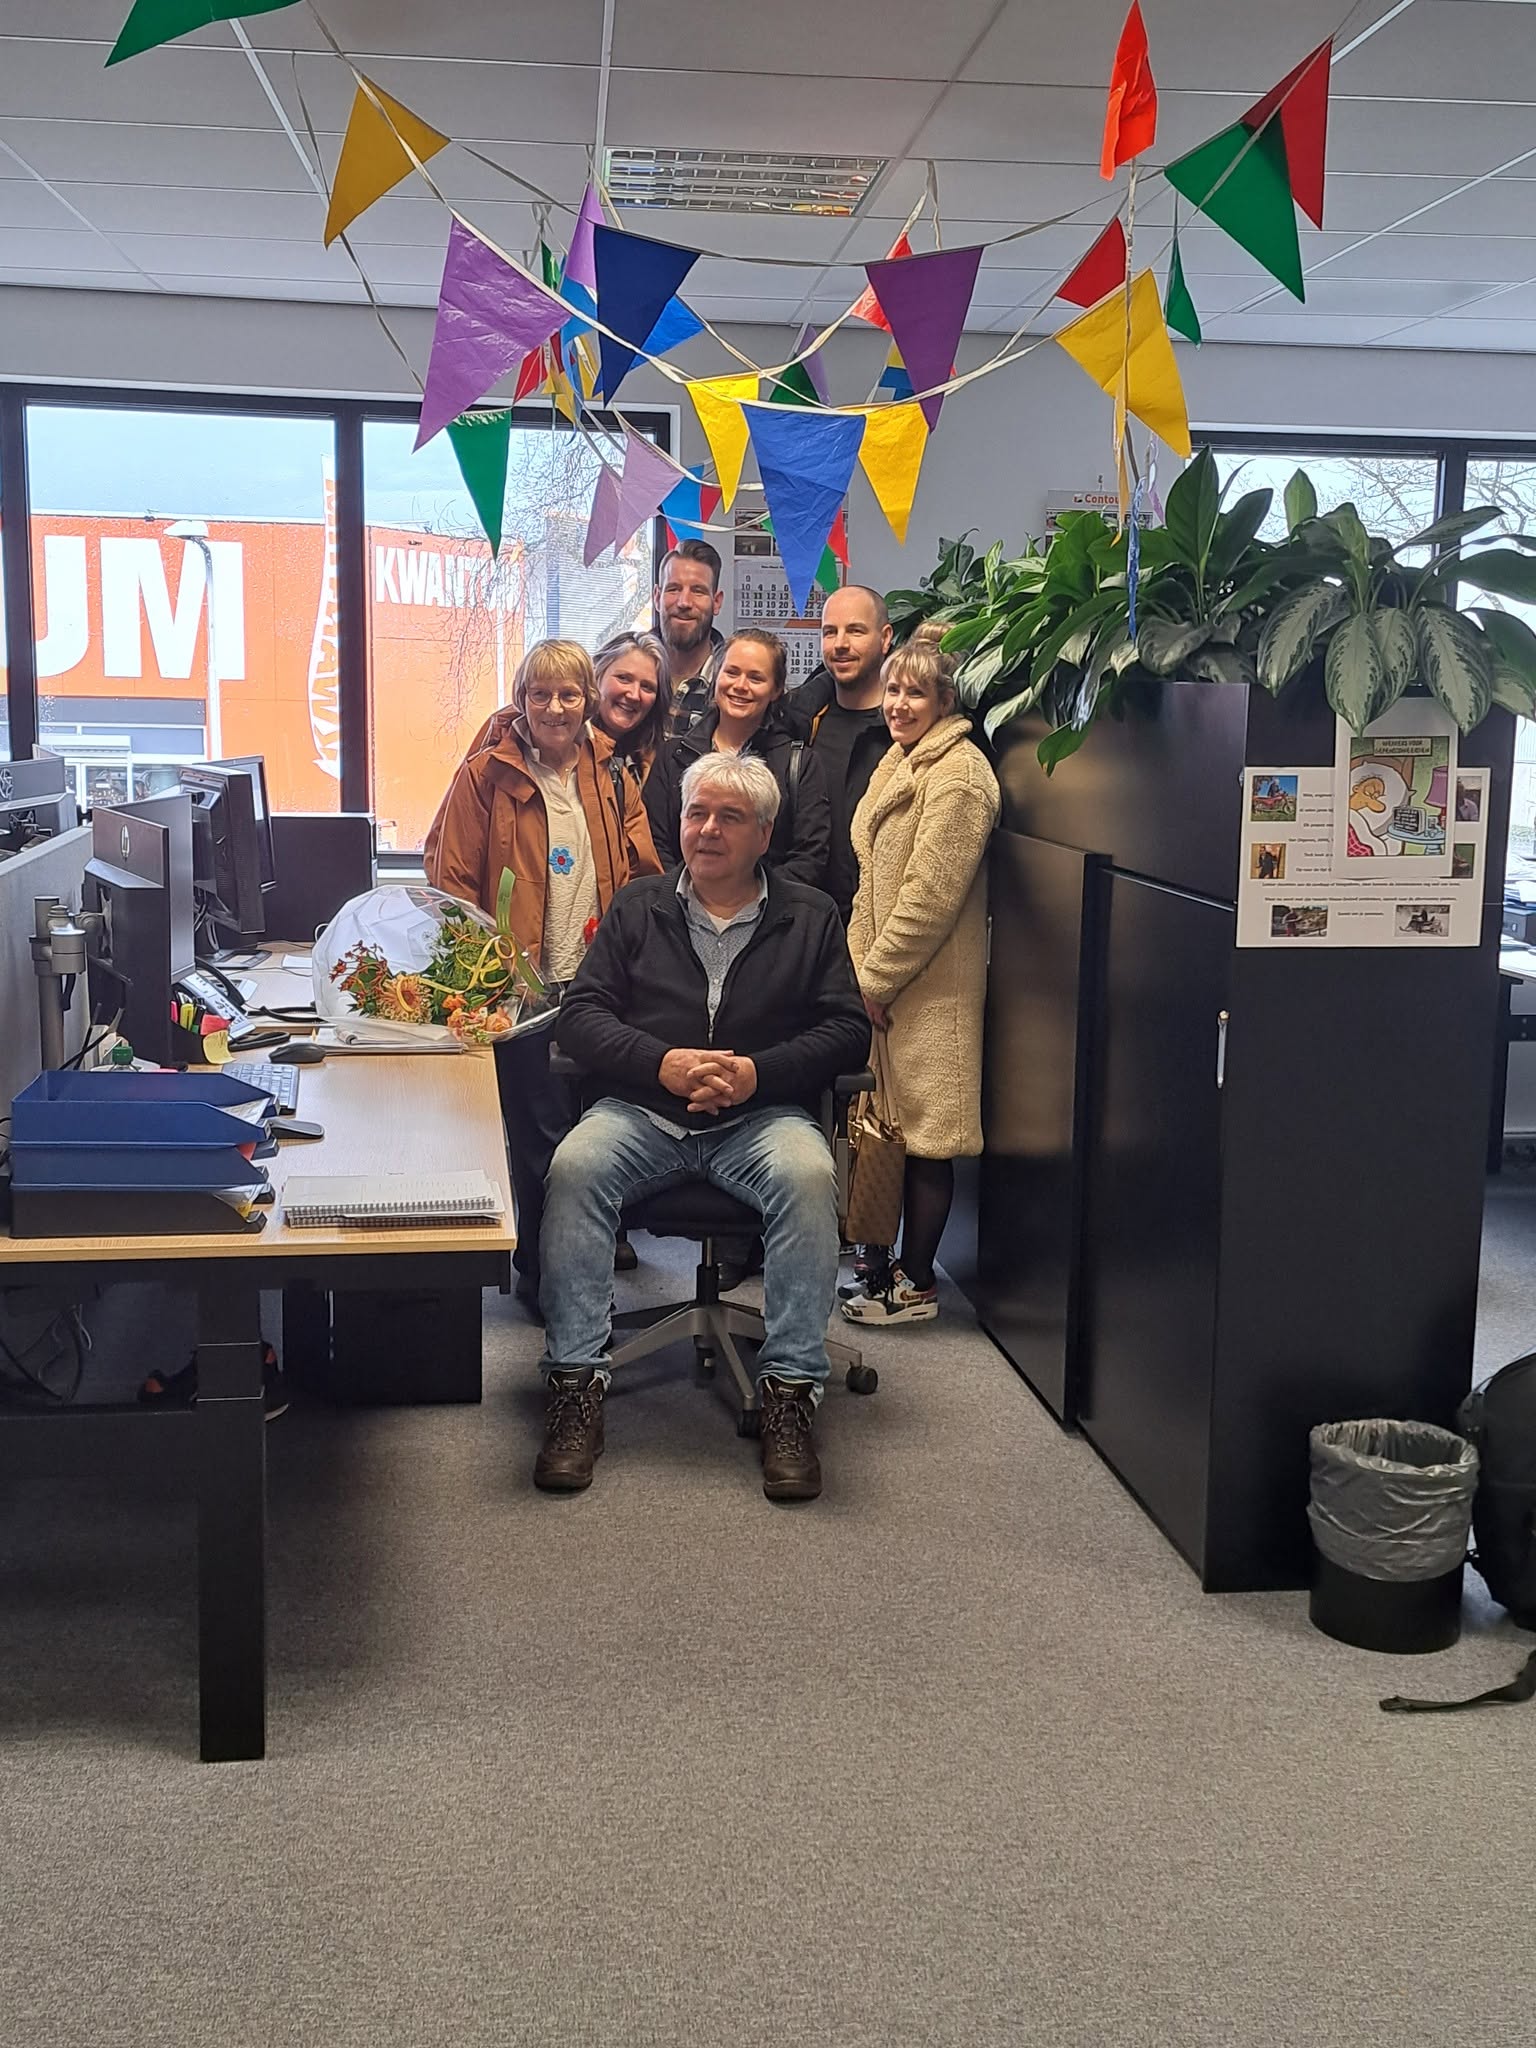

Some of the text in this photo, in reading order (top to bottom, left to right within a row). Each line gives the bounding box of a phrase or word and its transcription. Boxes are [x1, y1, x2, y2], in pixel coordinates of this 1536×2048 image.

[771, 584, 776, 592] 5
[754, 592, 763, 600] 11
[780, 593, 789, 601] 13
[753, 609, 763, 617] 25
[804, 610, 814, 618] 29
[791, 650, 800, 658] 11
[804, 650, 813, 658] 12
